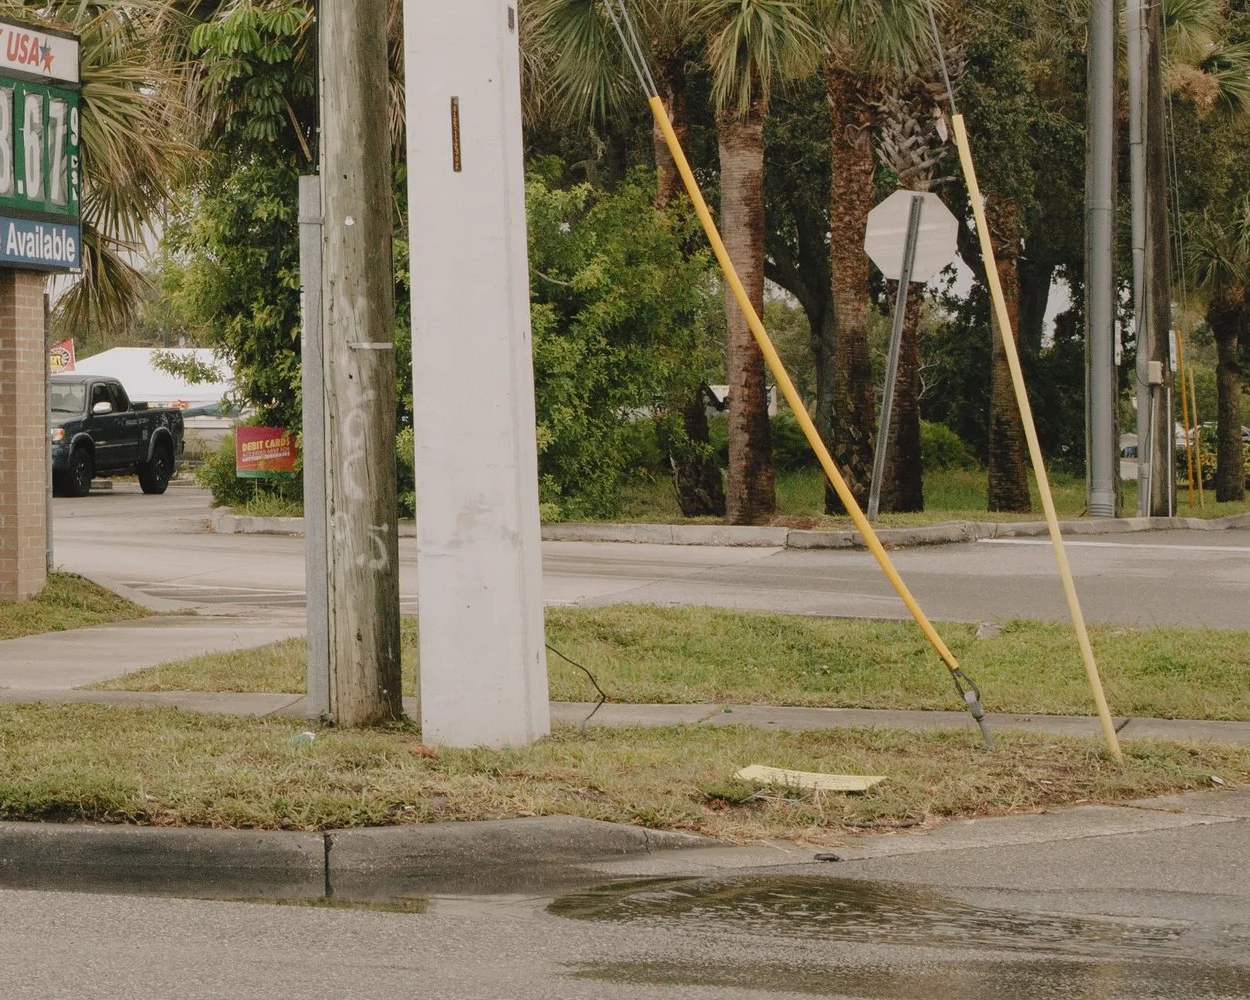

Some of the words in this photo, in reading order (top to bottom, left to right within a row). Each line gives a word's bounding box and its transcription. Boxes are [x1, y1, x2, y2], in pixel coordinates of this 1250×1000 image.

[6, 31, 40, 67] USA
[6, 222, 76, 263] Available
[242, 440, 264, 452] DEBIT
[265, 437, 290, 449] CARDS
